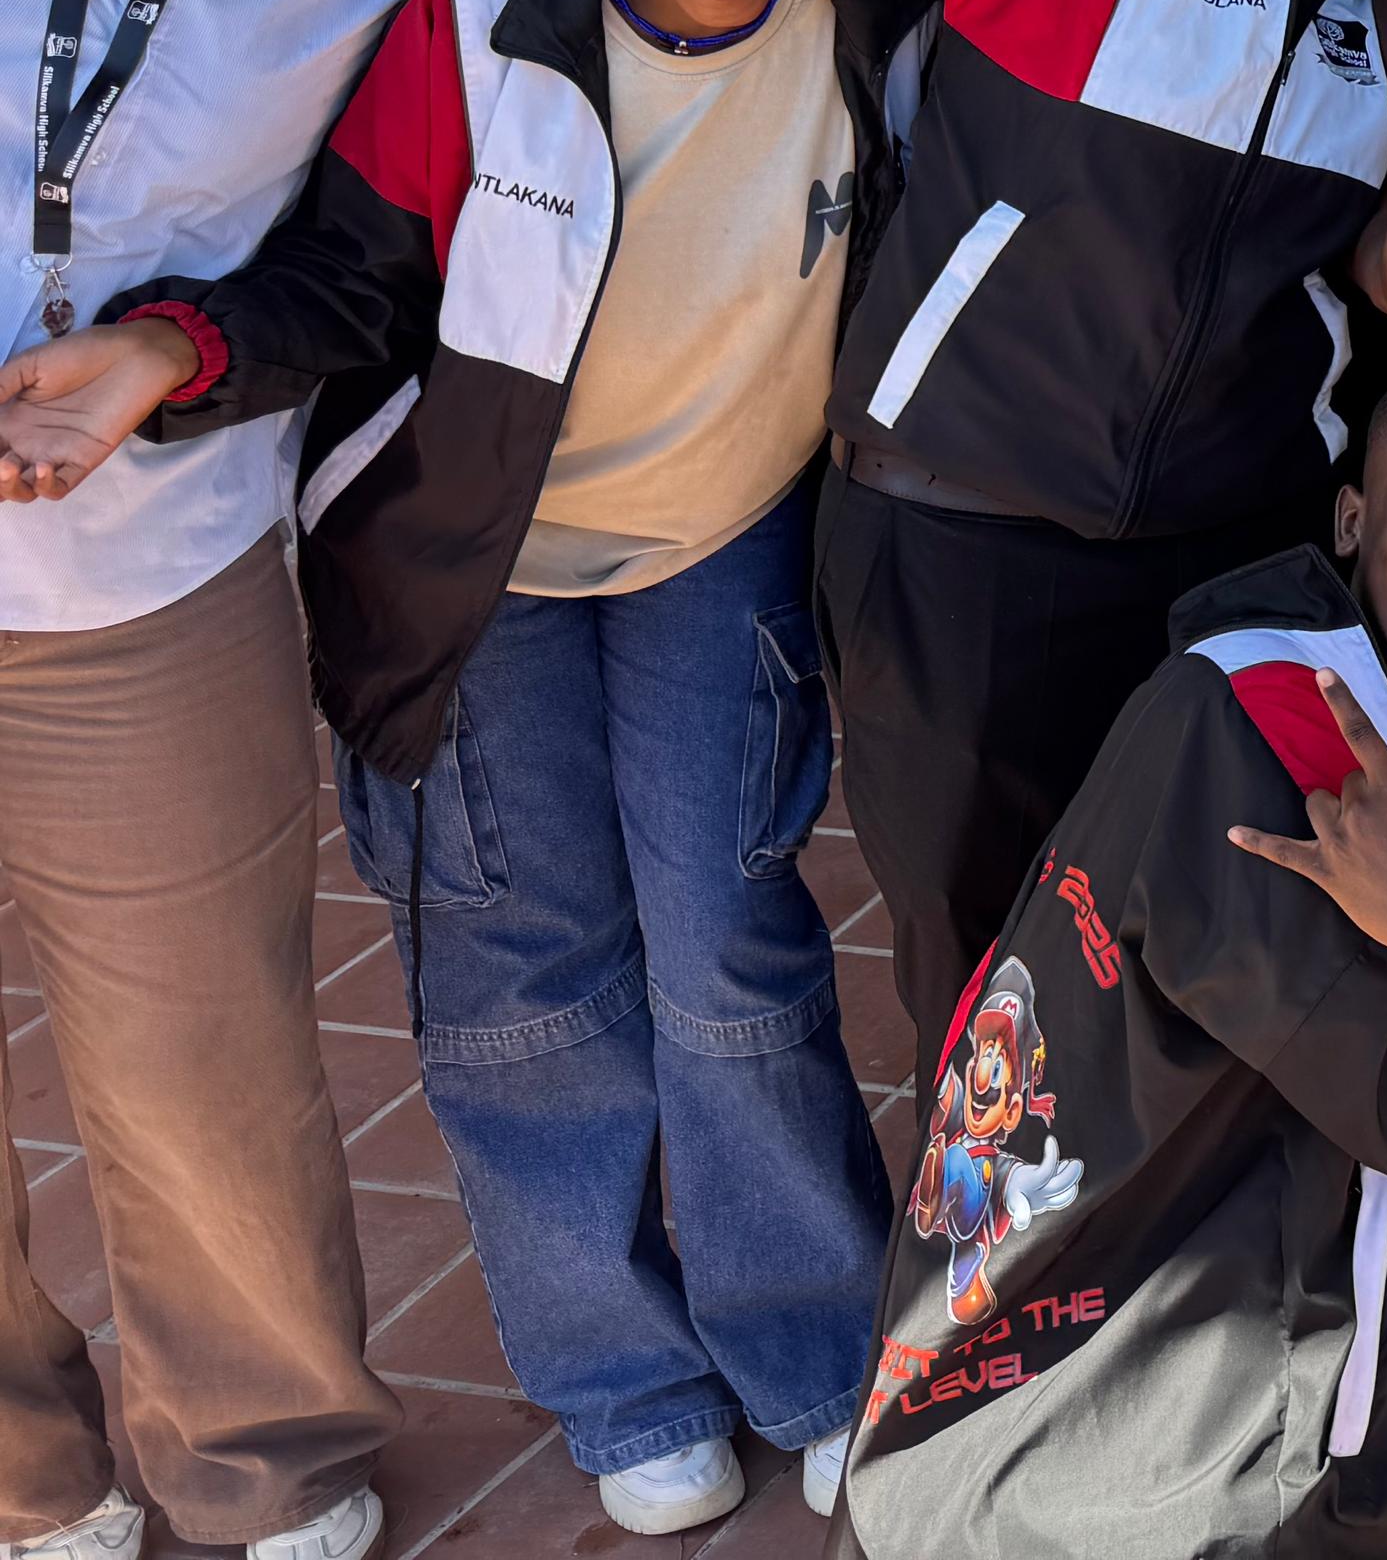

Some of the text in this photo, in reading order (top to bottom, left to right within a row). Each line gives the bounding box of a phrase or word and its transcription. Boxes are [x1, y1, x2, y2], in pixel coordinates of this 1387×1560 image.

[953, 1317, 1012, 1356] TO
[1021, 1287, 1106, 1331] THE
[900, 1352, 1039, 1415] LEVEL
